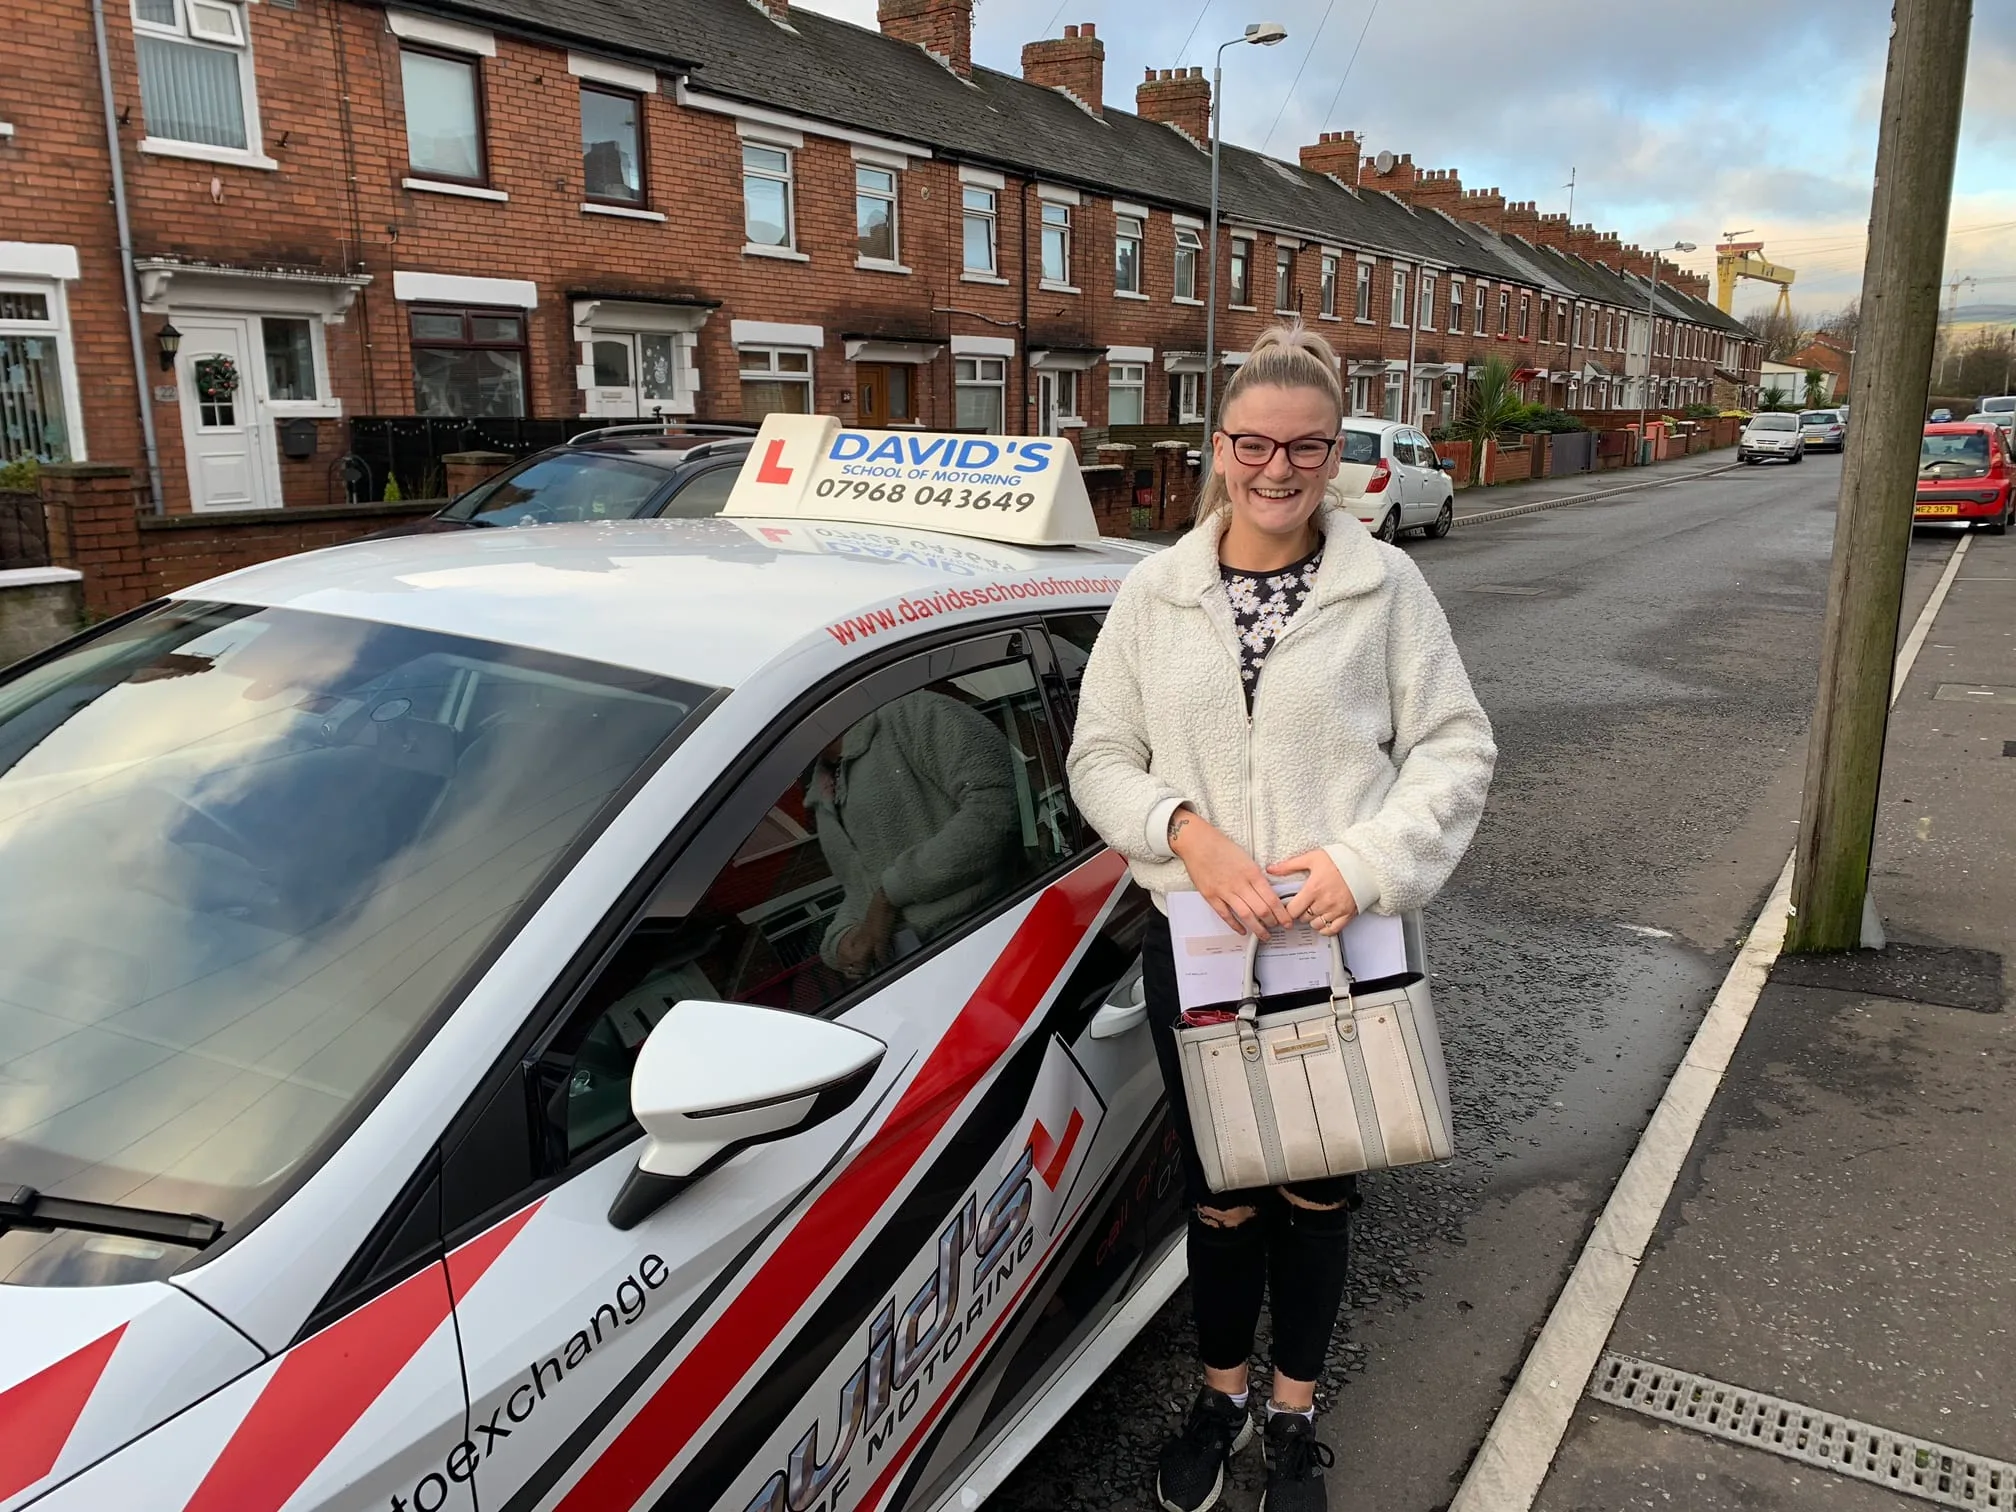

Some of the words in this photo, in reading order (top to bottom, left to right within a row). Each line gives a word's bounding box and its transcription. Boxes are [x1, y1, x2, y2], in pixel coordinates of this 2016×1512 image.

[756, 439, 794, 485] L
[829, 433, 1053, 473] DAVID'S
[816, 478, 906, 503] 07968
[914, 486, 1035, 512] 043649
[841, 464, 902, 479] SCHOOL
[907, 468, 930, 480] OF
[932, 470, 1022, 486] MOTORING
[867, 1226, 1034, 1466] MOTORING
